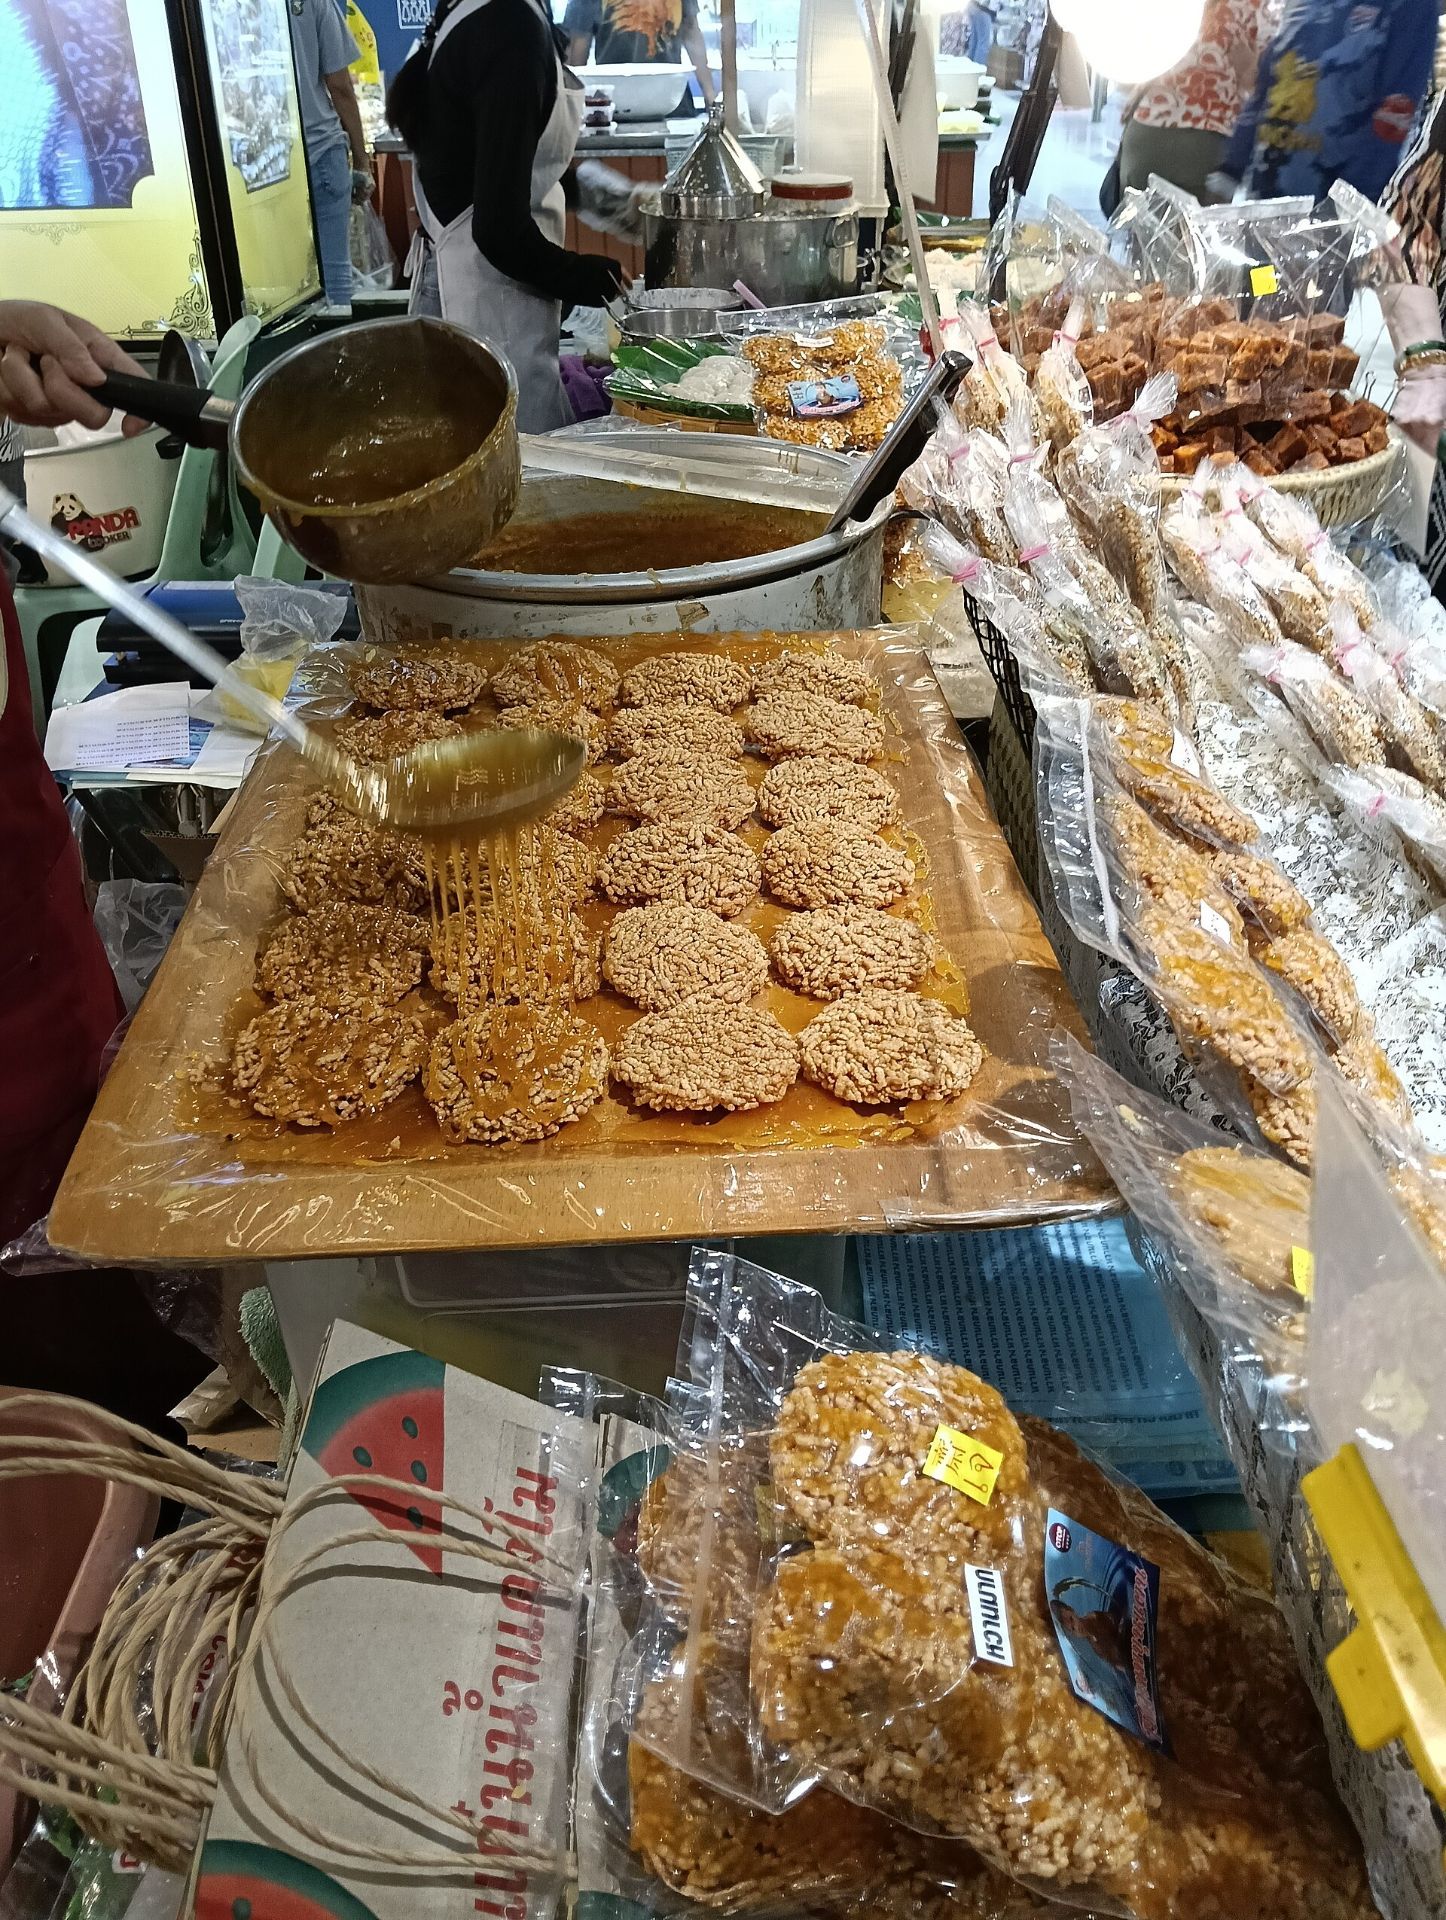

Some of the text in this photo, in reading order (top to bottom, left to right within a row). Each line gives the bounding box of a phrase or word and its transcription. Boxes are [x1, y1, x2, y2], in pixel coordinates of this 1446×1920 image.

[68, 507, 139, 540] PANDA
[974, 1568, 1006, 1661] หวานมาก
